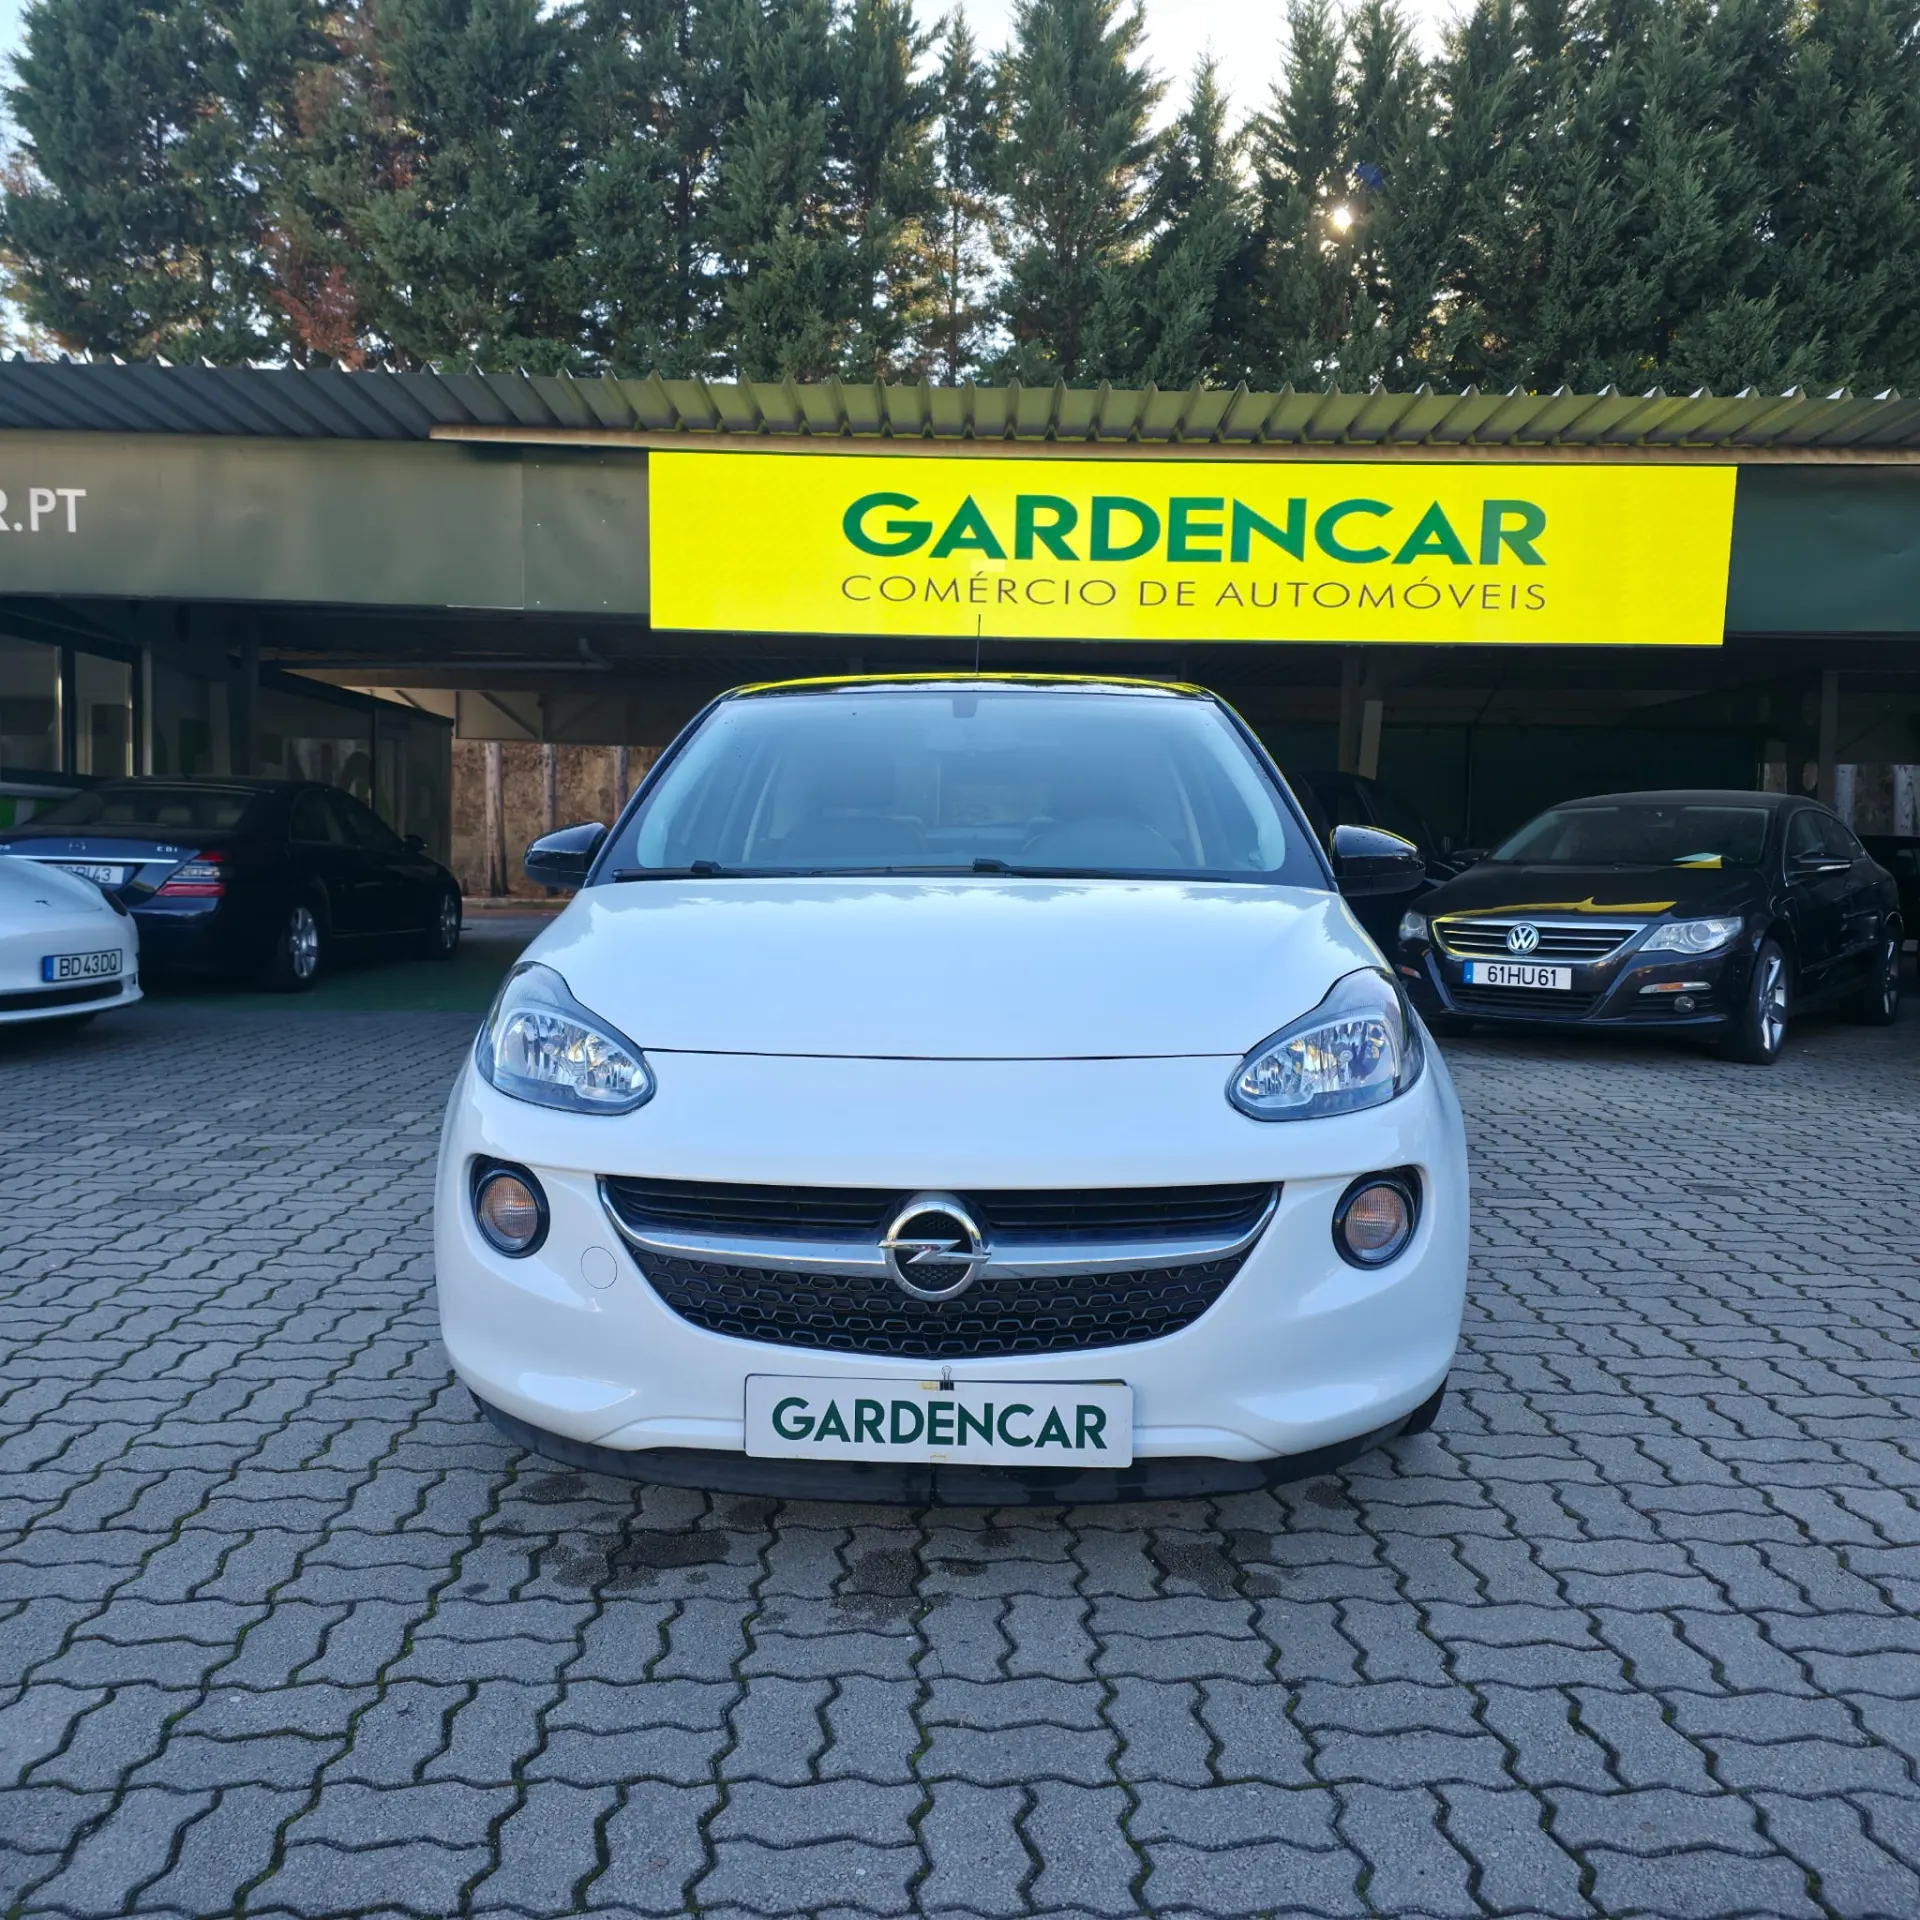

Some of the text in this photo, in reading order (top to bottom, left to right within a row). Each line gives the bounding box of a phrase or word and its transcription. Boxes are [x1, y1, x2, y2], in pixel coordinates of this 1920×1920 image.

[842, 491, 1548, 566] GARDENCAR
[841, 571, 1546, 611] COMÉRCIO DE AUTOMÓVEIS
[772, 1396, 1108, 1450] GARDENCAR
